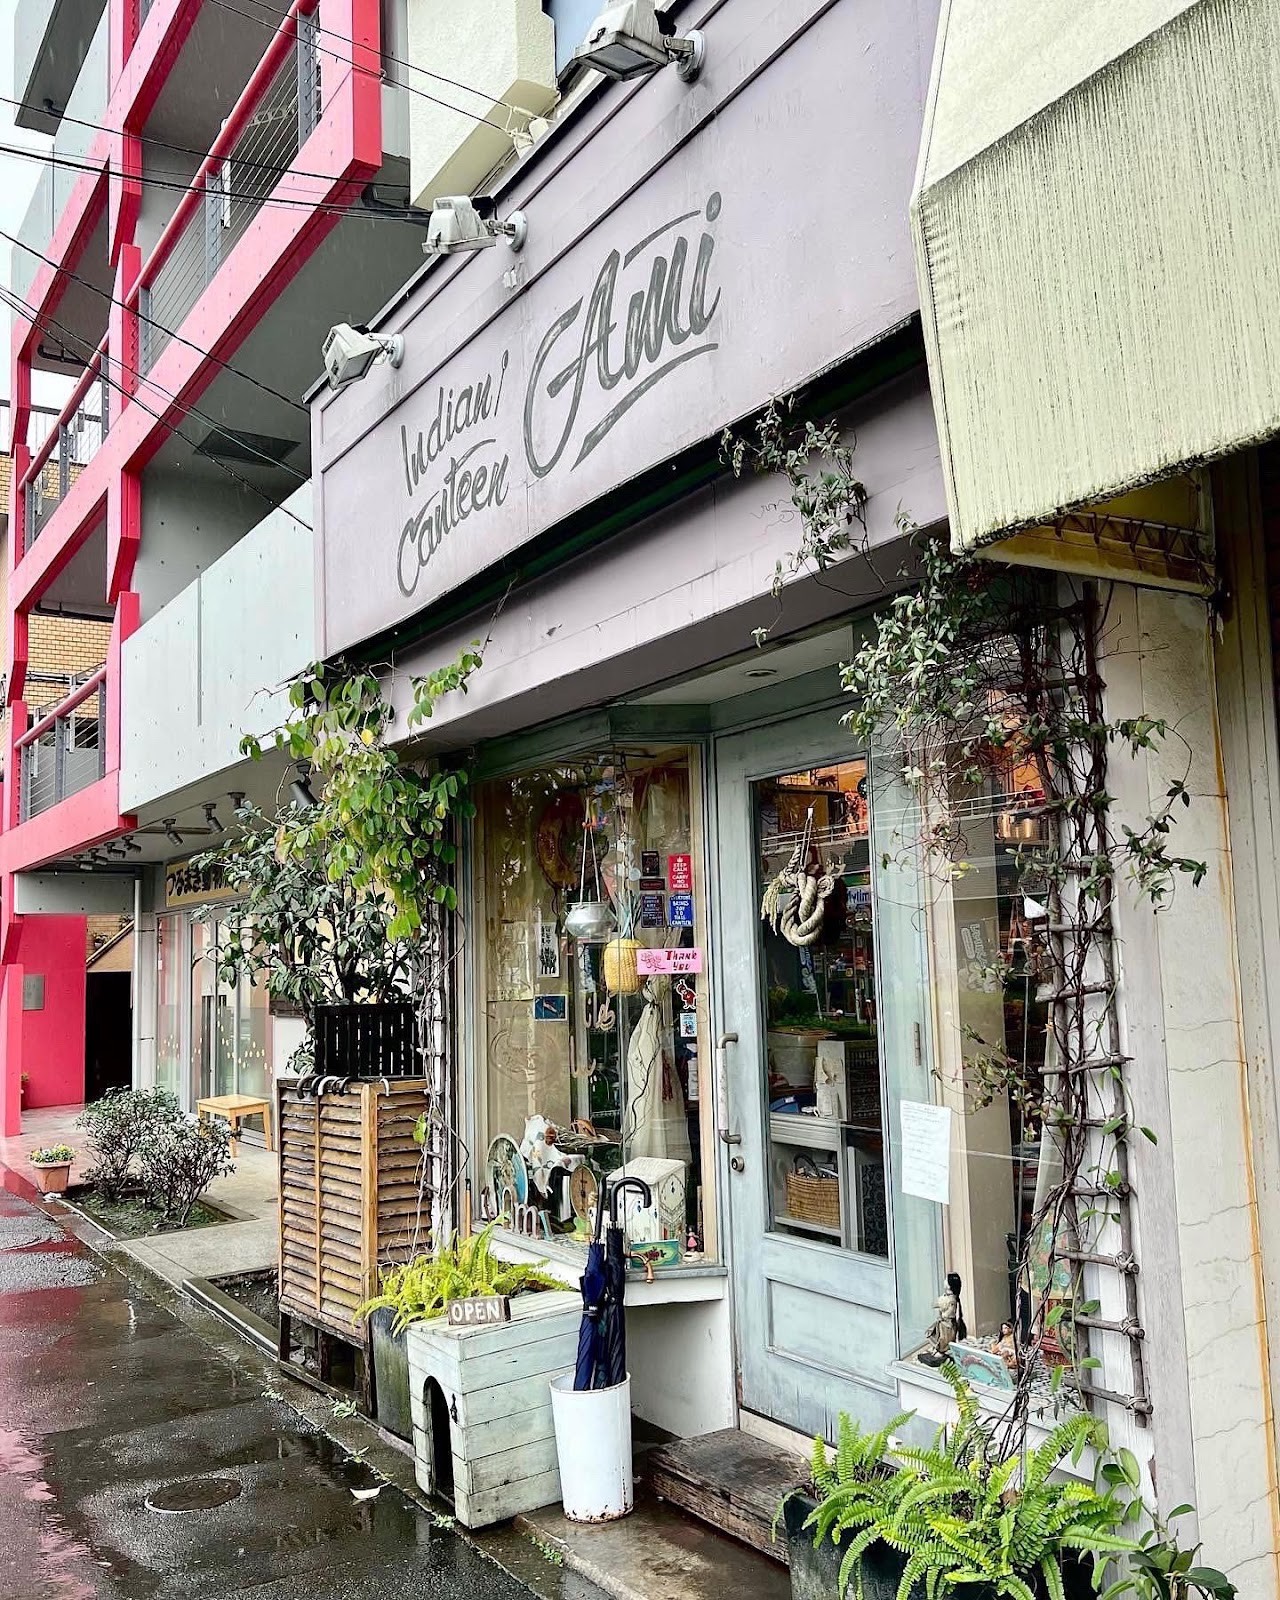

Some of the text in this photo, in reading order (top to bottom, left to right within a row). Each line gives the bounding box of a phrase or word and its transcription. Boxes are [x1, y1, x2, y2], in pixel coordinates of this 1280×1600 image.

[523, 190, 723, 480] Ami
[400, 373, 494, 497] Indian
[397, 438, 510, 598] Canteen
[451, 1300, 500, 1322] OPEN
